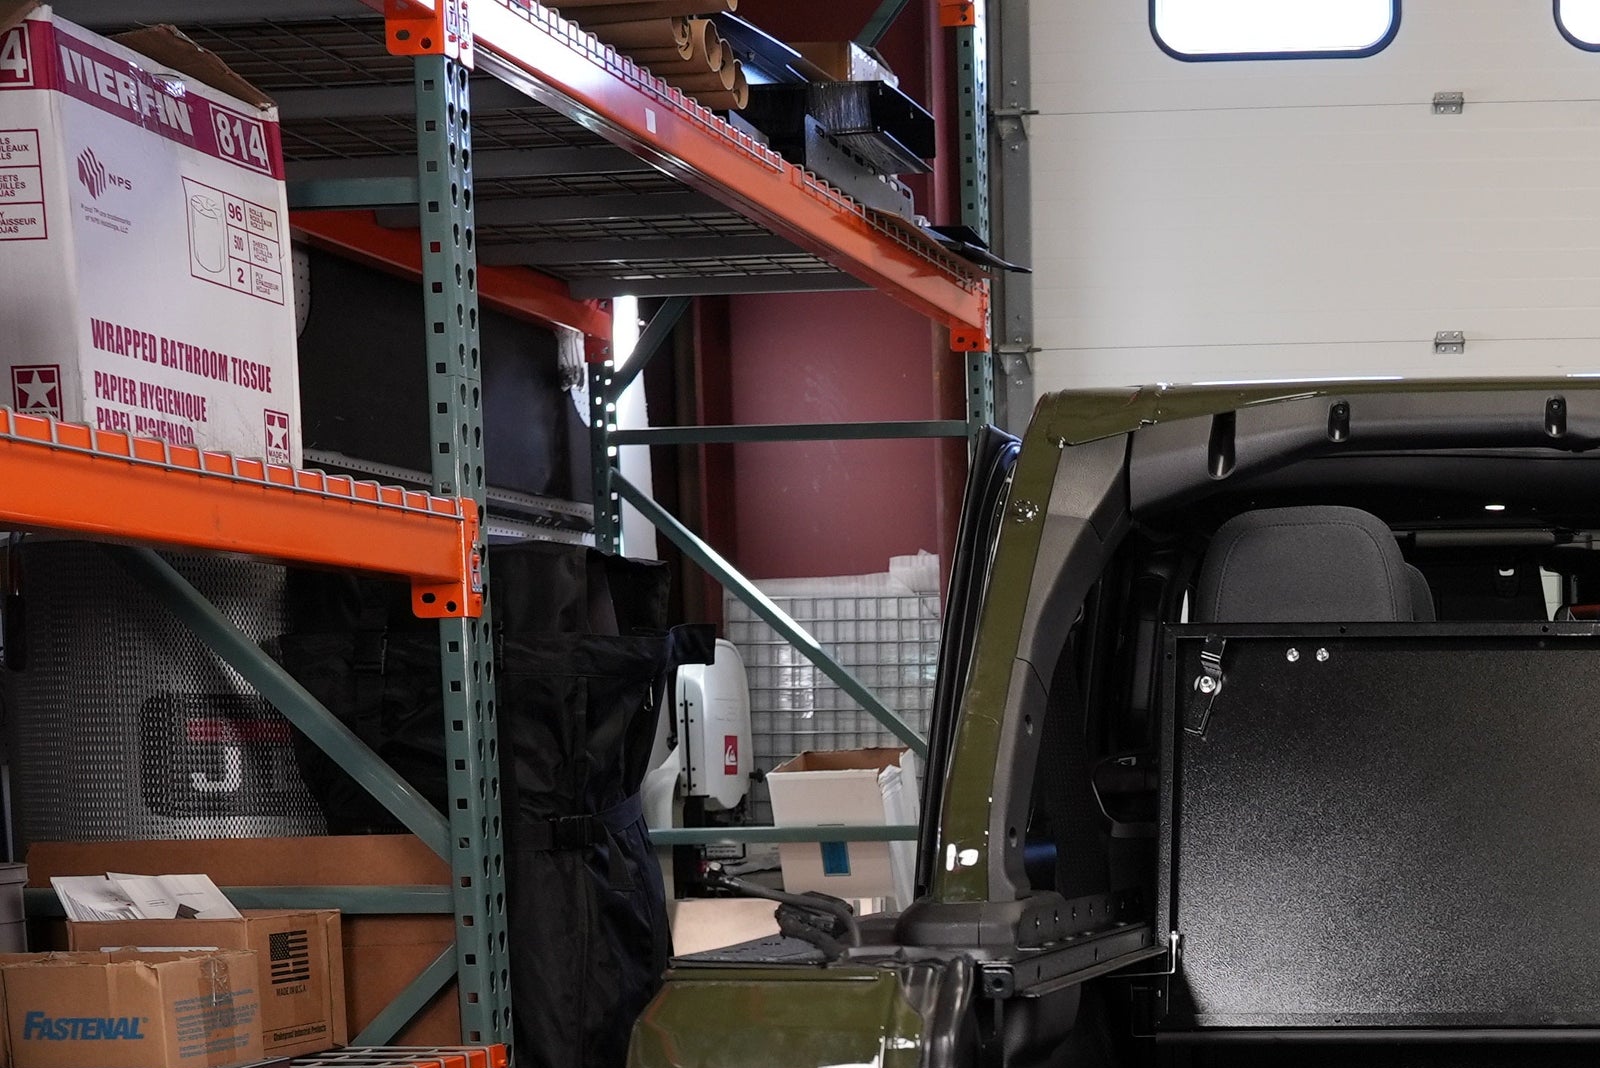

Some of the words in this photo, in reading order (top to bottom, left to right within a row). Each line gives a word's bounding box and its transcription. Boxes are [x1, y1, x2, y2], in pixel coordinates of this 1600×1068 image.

[59, 45, 194, 137] MERFIN
[216, 111, 268, 167] 814
[108, 173, 132, 191] NPS
[228, 202, 243, 222] 96
[237, 267, 245, 284] 2
[90, 317, 157, 364] WRAPPED
[160, 337, 229, 383] BATHROOM
[231, 356, 272, 393] TISSUE
[94, 370, 137, 406] PAPIER
[139, 382, 207, 423] HYGIENIQUE
